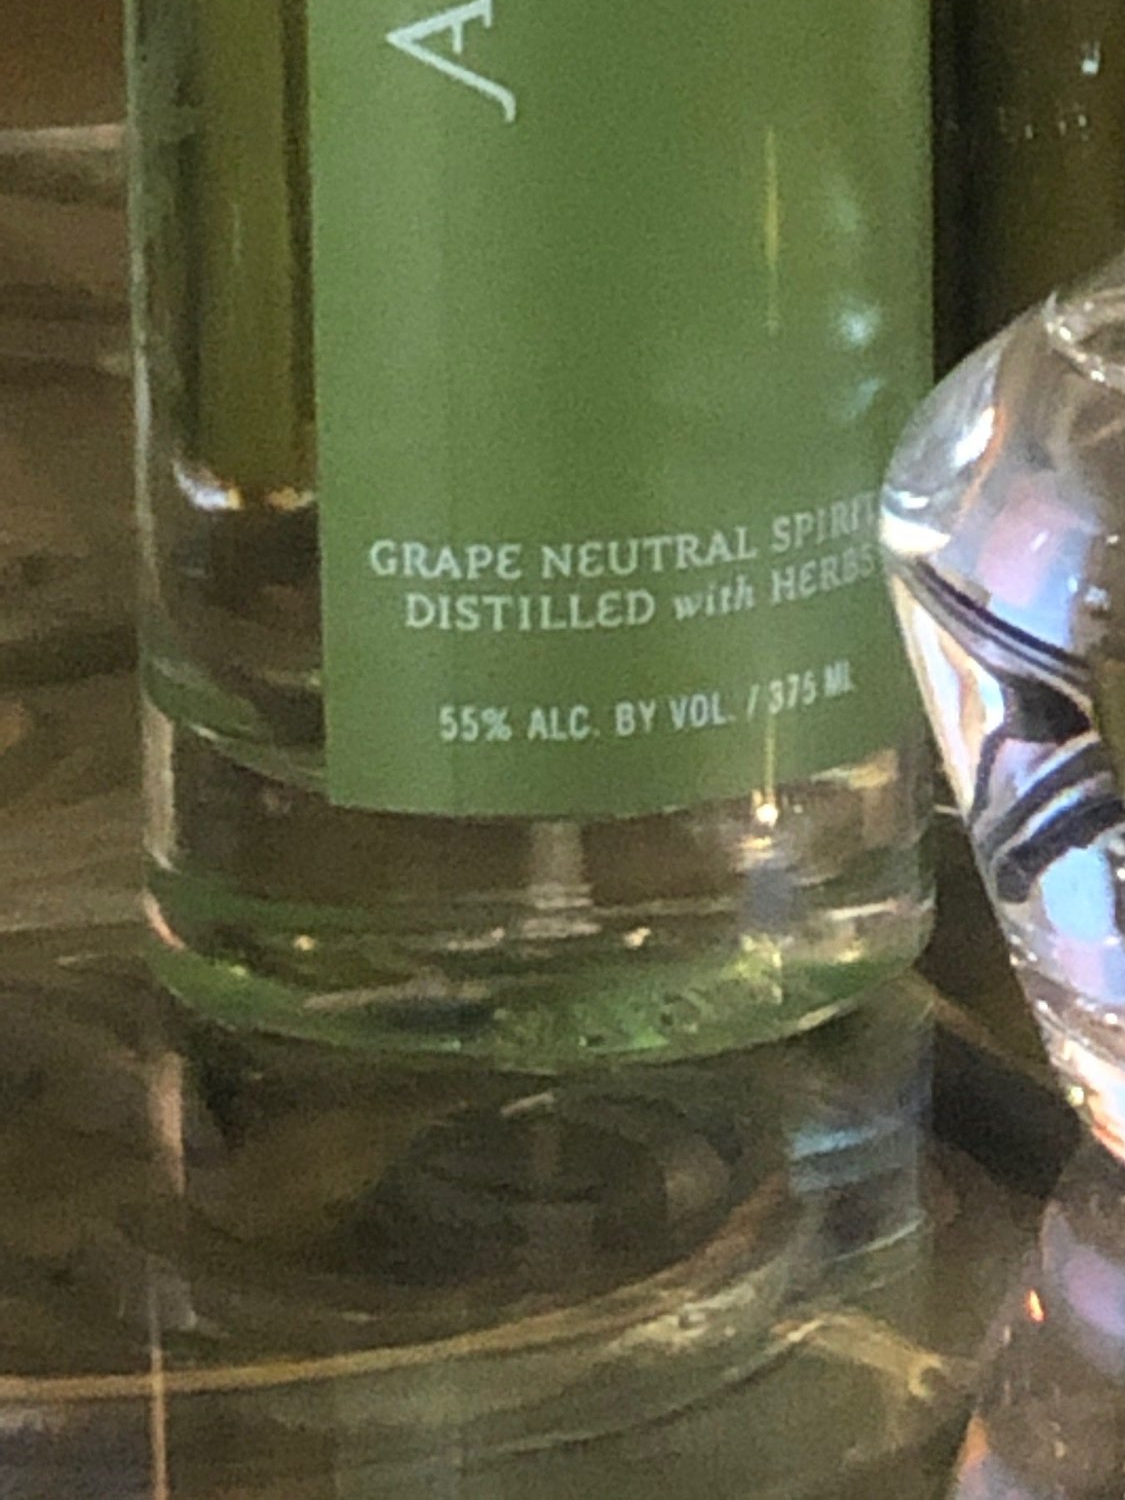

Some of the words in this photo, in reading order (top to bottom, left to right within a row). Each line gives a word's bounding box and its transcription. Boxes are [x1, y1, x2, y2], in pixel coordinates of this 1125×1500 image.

[369, 538, 522, 580] GRAPE
[541, 526, 757, 578] NEUTRAL
[405, 590, 655, 630] DISTILLED
[673, 574, 754, 622] with
[439, 705, 513, 743] 55%
[527, 704, 601, 742] ALC.
[614, 696, 655, 737] BY
[669, 691, 736, 730] VOL.
[767, 668, 817, 716] 375
